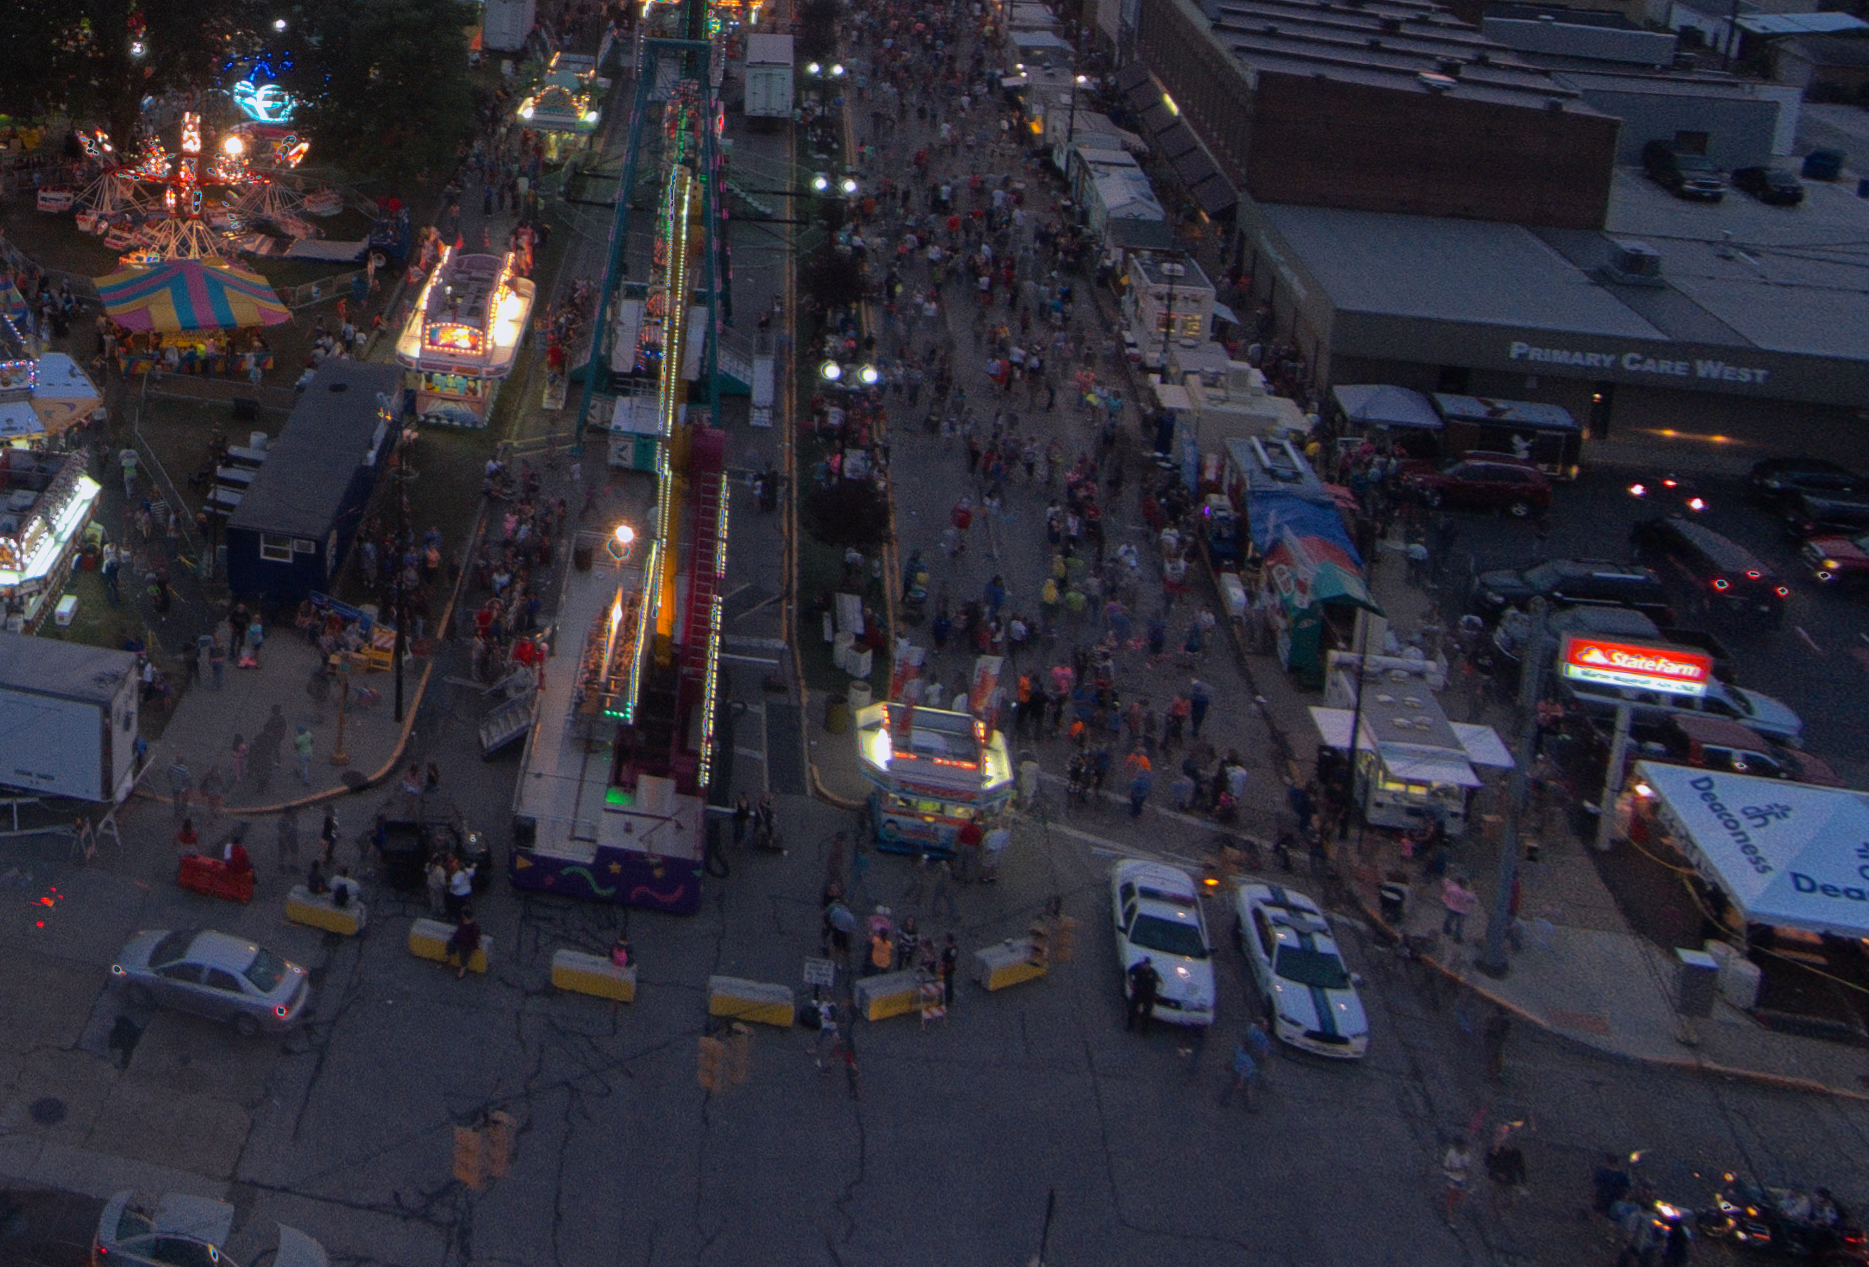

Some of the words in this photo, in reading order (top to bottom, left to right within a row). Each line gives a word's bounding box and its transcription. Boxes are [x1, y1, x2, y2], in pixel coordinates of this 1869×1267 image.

[1509, 341, 1616, 368] PRIMARY
[1621, 352, 1690, 376] CARE
[1694, 359, 1769, 382] WEST
[1607, 650, 1656, 671] State
[1655, 657, 1702, 678] Farm
[1690, 776, 1774, 874] Deaconess
[1790, 872, 1869, 901] Dea
